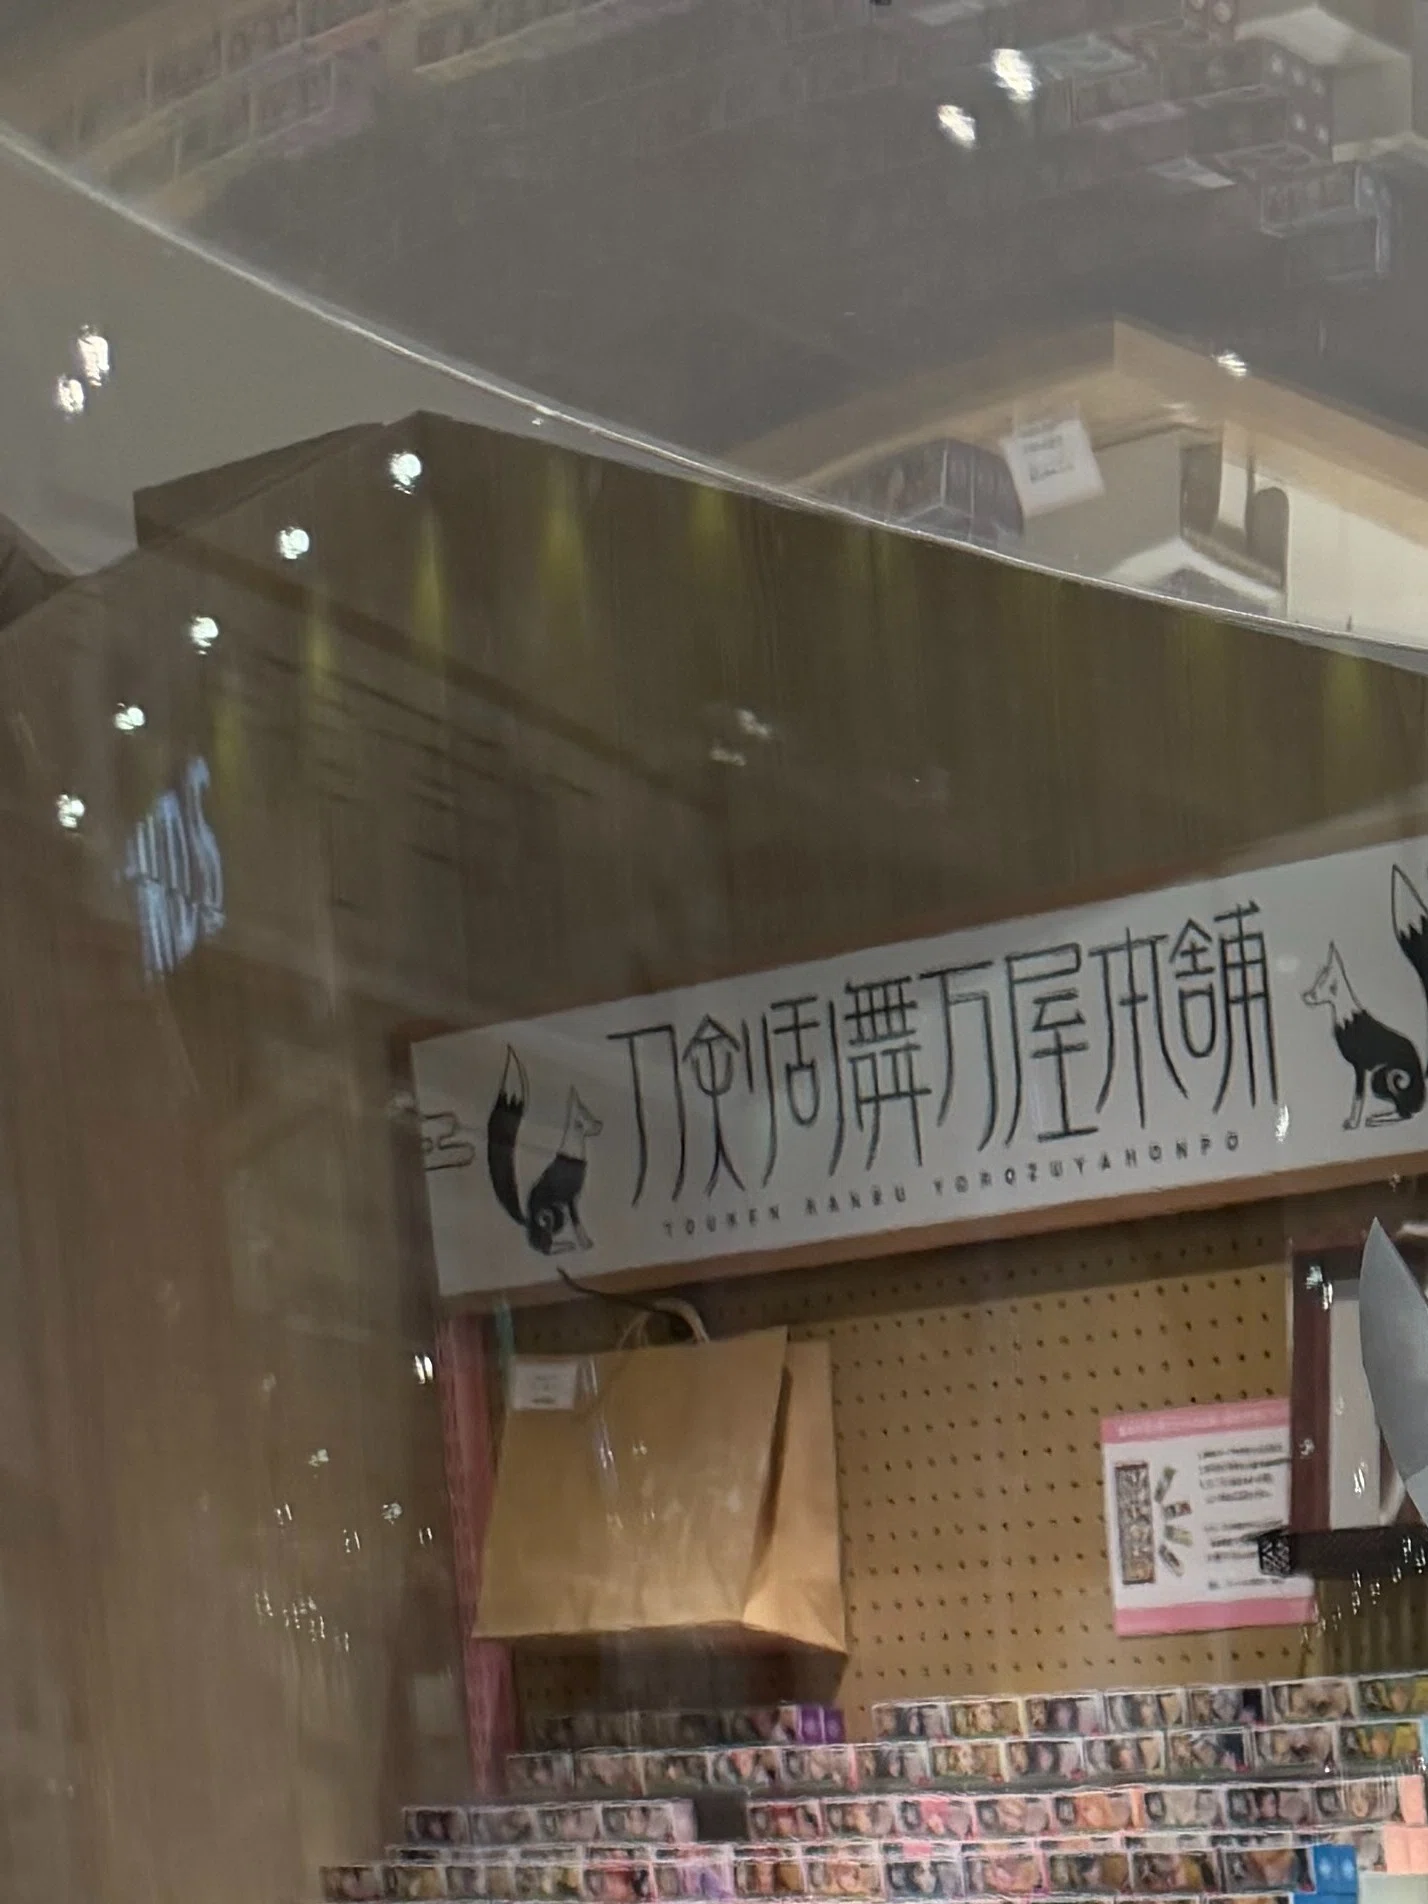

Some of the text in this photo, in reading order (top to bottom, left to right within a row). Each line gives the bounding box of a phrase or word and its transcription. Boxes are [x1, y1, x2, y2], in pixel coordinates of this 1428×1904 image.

[663, 1130, 1241, 1239] TOUKEN RANBU YOROZUYAHONPO
